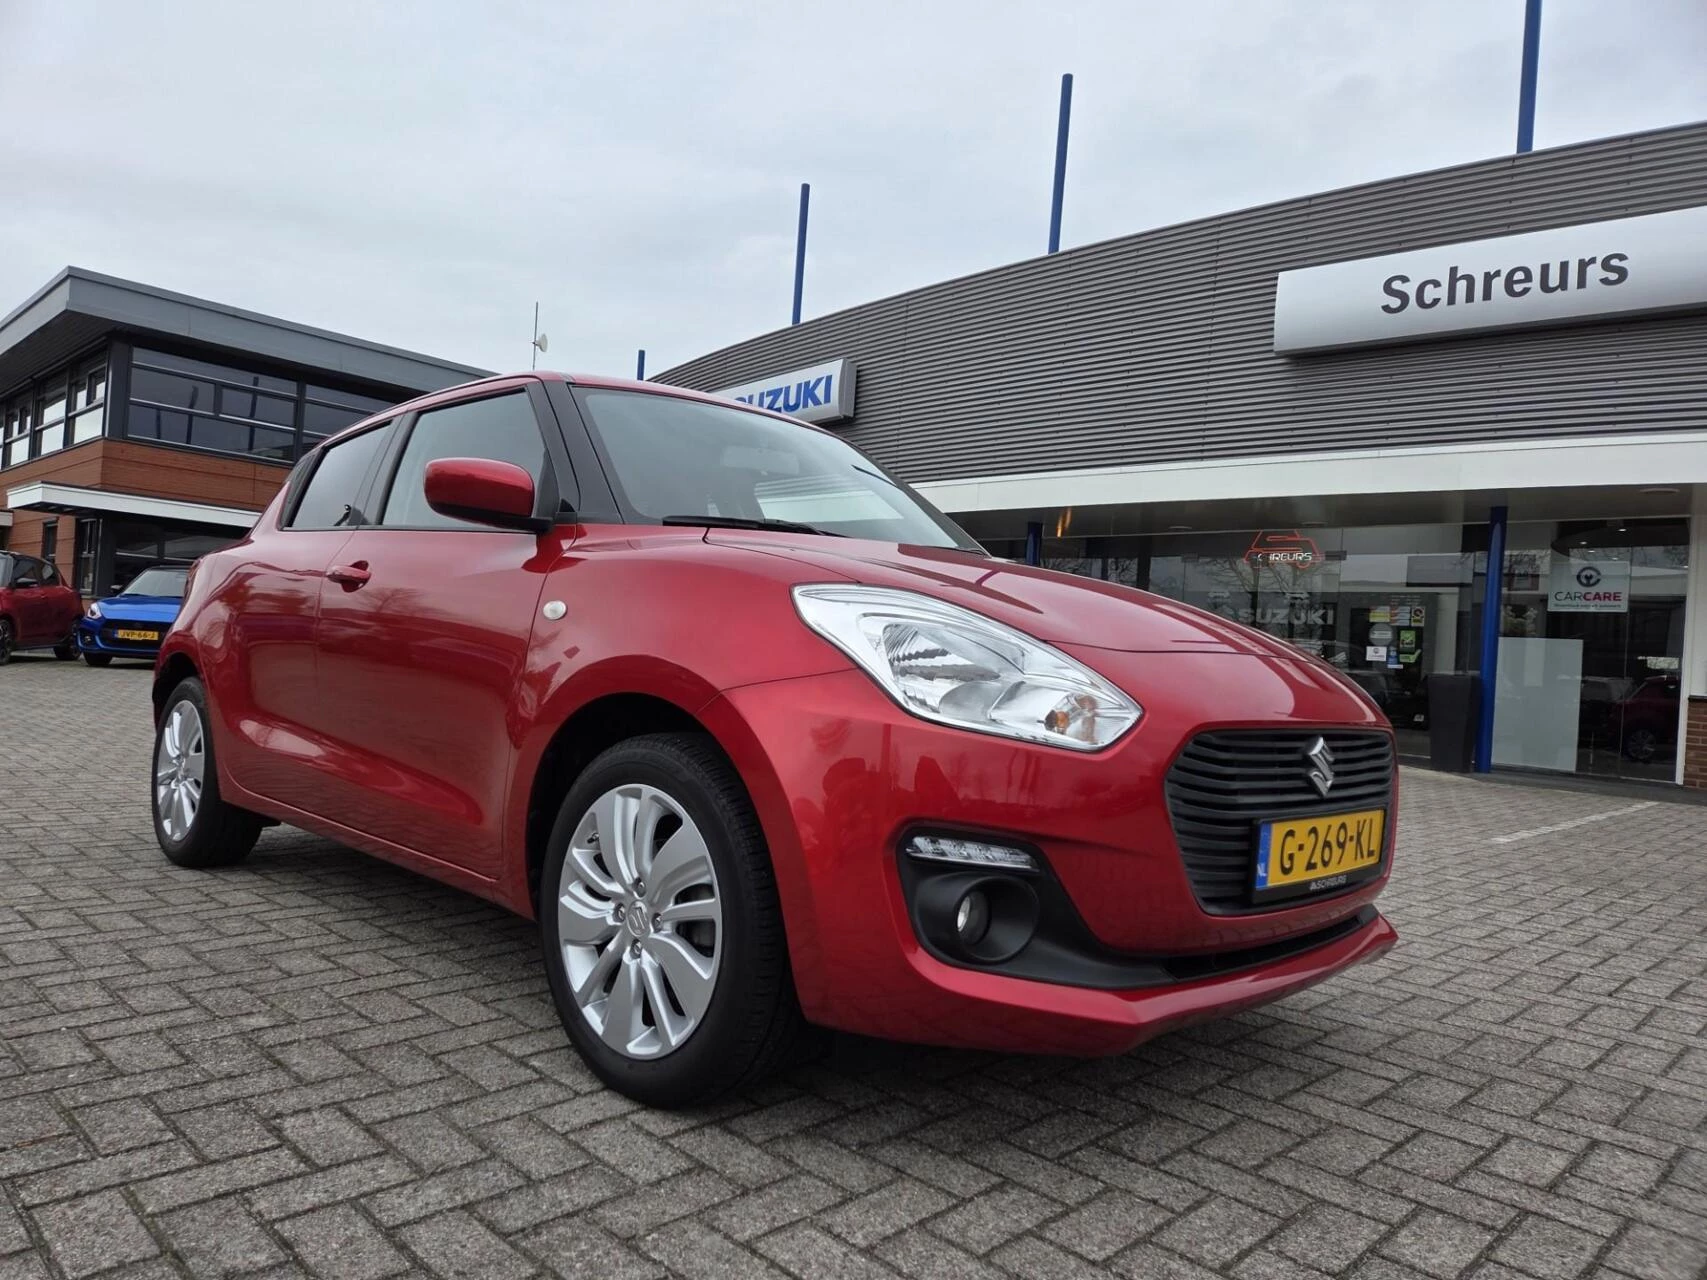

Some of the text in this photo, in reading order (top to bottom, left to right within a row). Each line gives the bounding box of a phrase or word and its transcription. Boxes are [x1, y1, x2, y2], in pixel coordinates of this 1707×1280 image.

[1380, 252, 1629, 315] Schreurs
[734, 374, 833, 414] UZUKI
[1554, 591, 1623, 602] CARCARE
[1238, 608, 1335, 626] SUZUKI
[1279, 818, 1376, 876] G-269-KL
